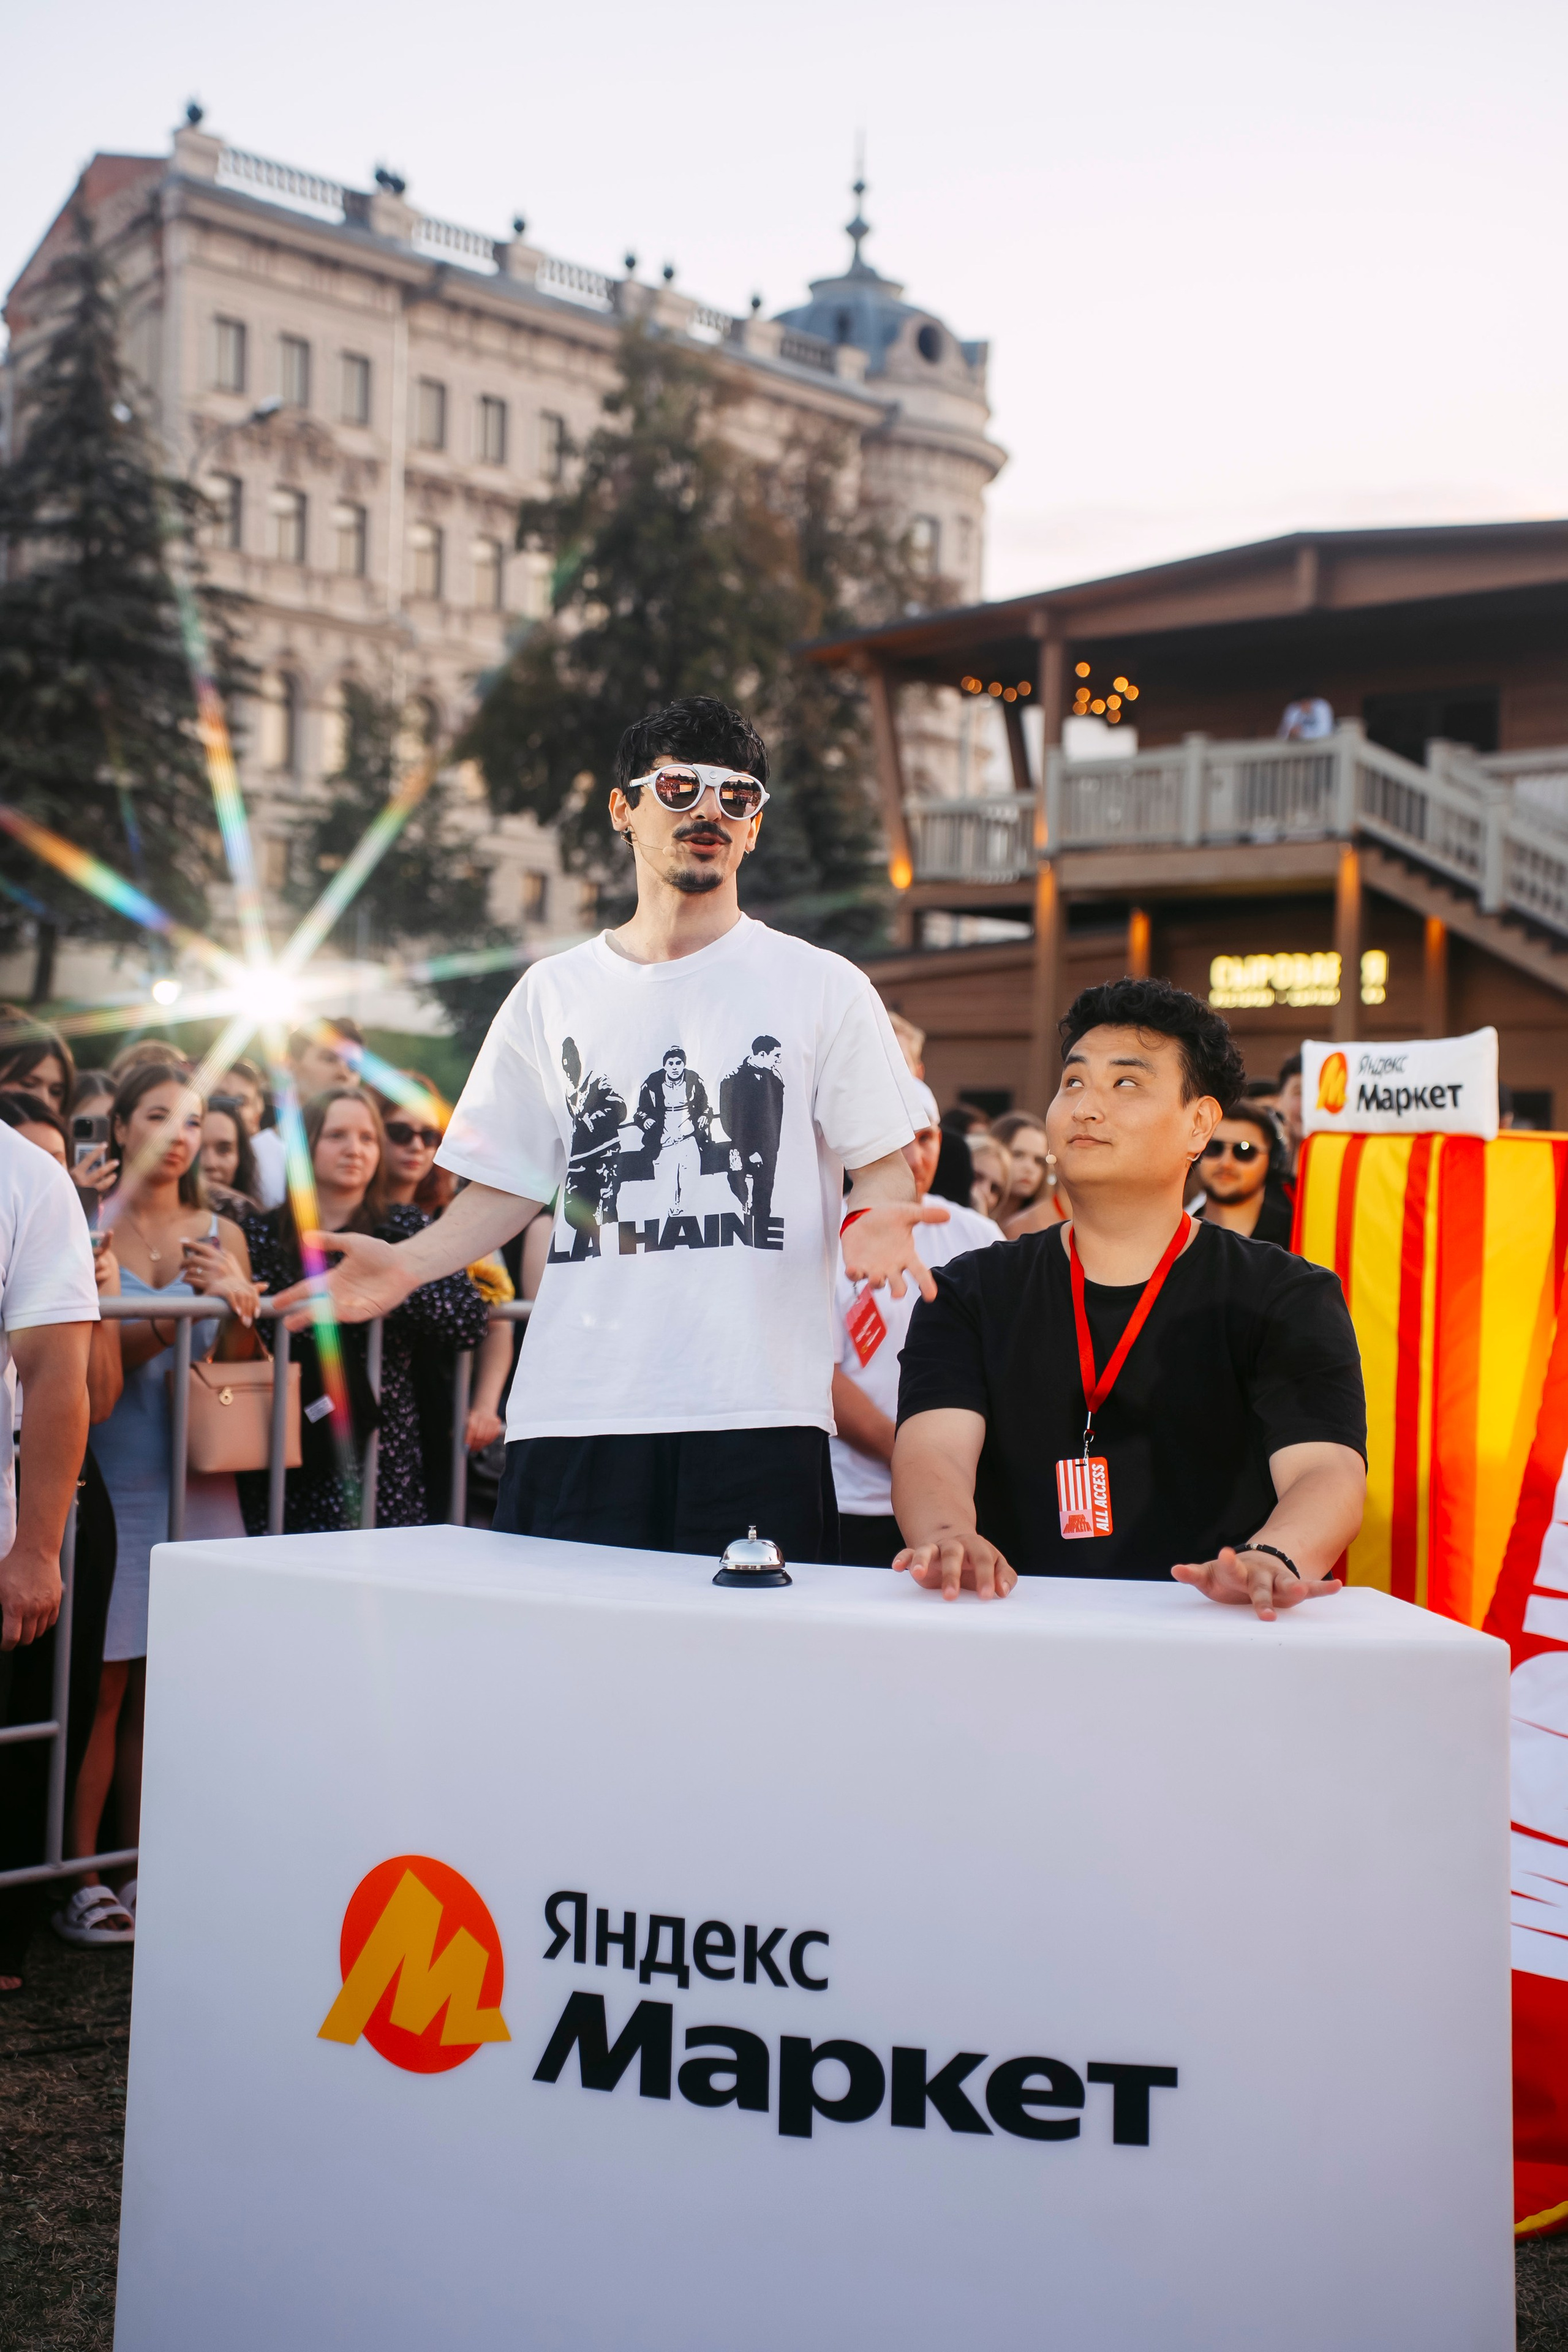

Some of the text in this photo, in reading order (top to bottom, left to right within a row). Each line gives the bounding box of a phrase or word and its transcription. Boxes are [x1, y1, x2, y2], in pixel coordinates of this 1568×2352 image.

[1357, 1055, 1408, 1077] Яндекс
[1357, 1084, 1463, 1117] Маркет
[547, 1212, 785, 1264] LA HAINE
[1091, 1463, 1110, 1532] ALL ACCESS
[542, 1890, 830, 1991] Яндекс
[532, 1991, 1178, 2147] Маркет
